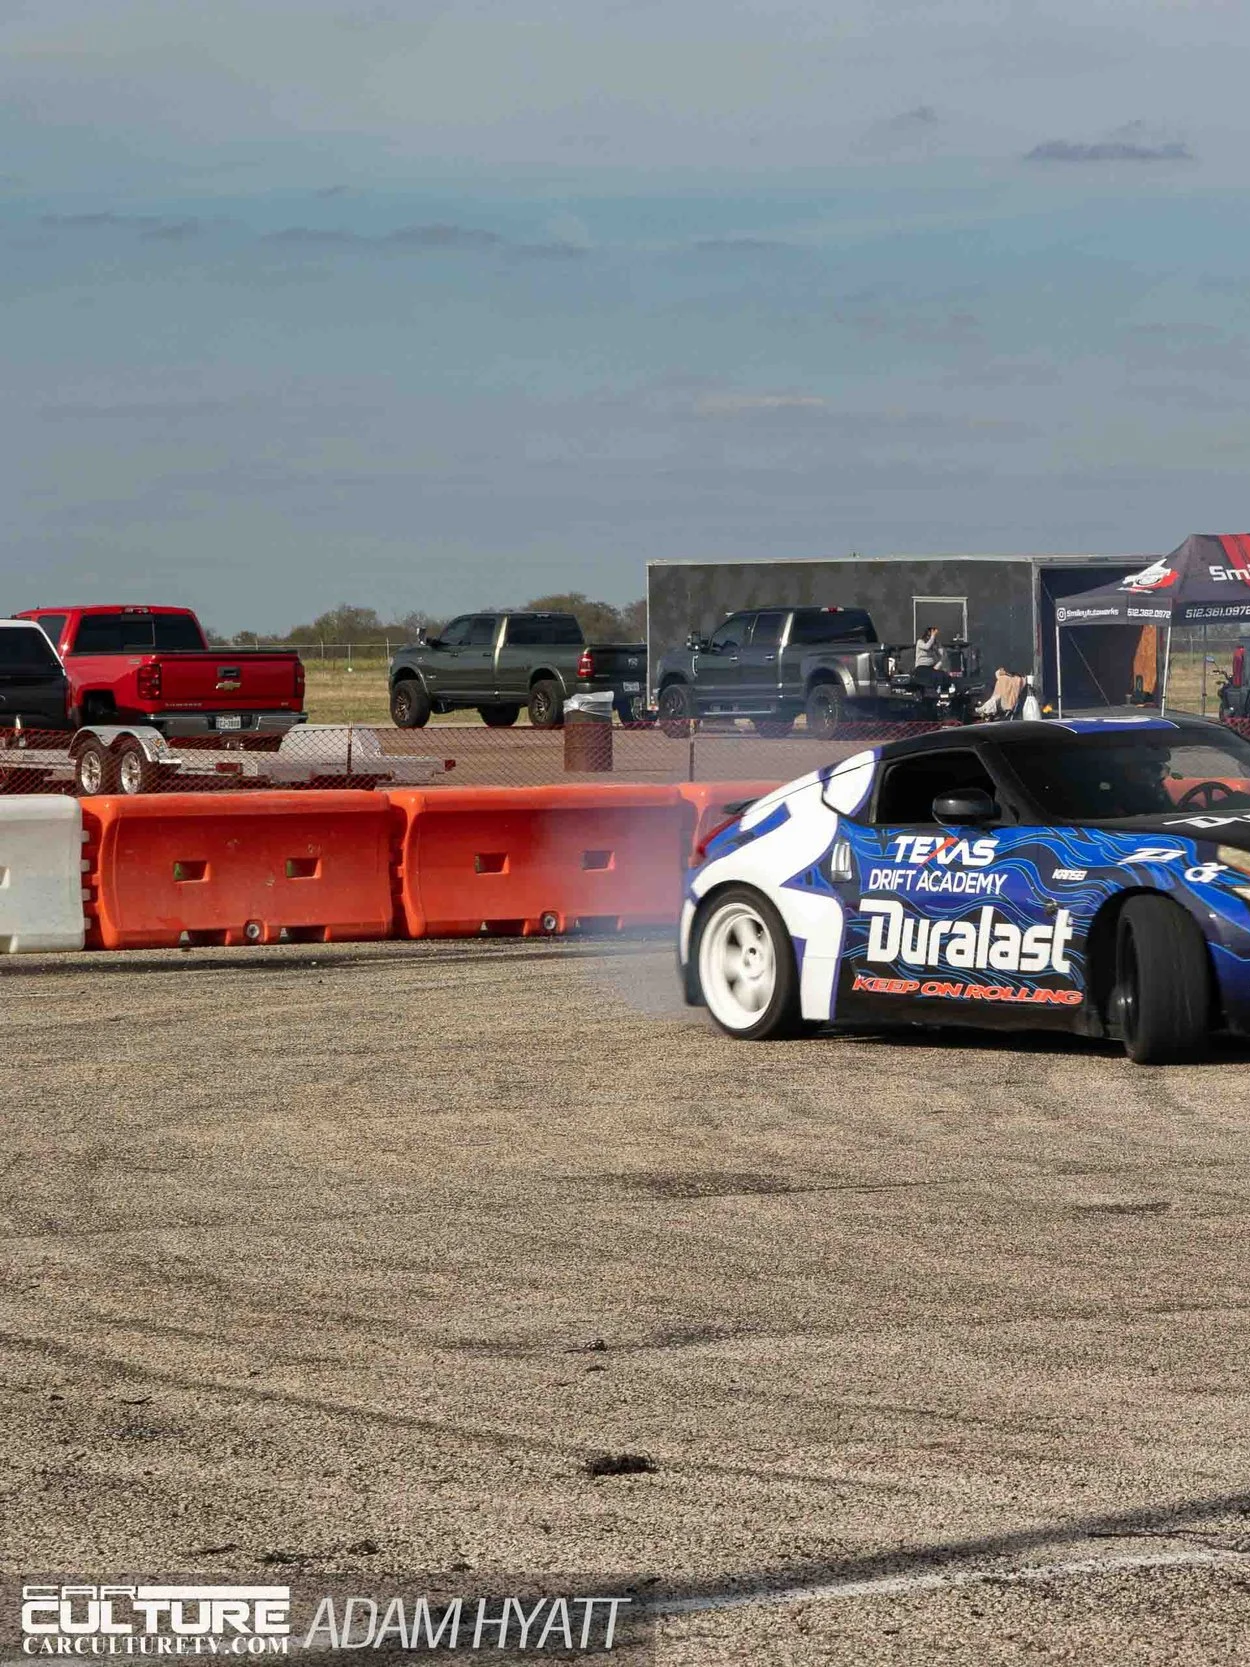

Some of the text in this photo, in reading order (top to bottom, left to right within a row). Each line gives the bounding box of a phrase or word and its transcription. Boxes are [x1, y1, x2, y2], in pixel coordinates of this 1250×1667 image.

[894, 836, 999, 866] TEXAS
[868, 869, 1008, 895] DRIFT ACADEMY
[859, 899, 1073, 974] Duralast
[852, 975, 1084, 1005] KEEP ON ROLLING
